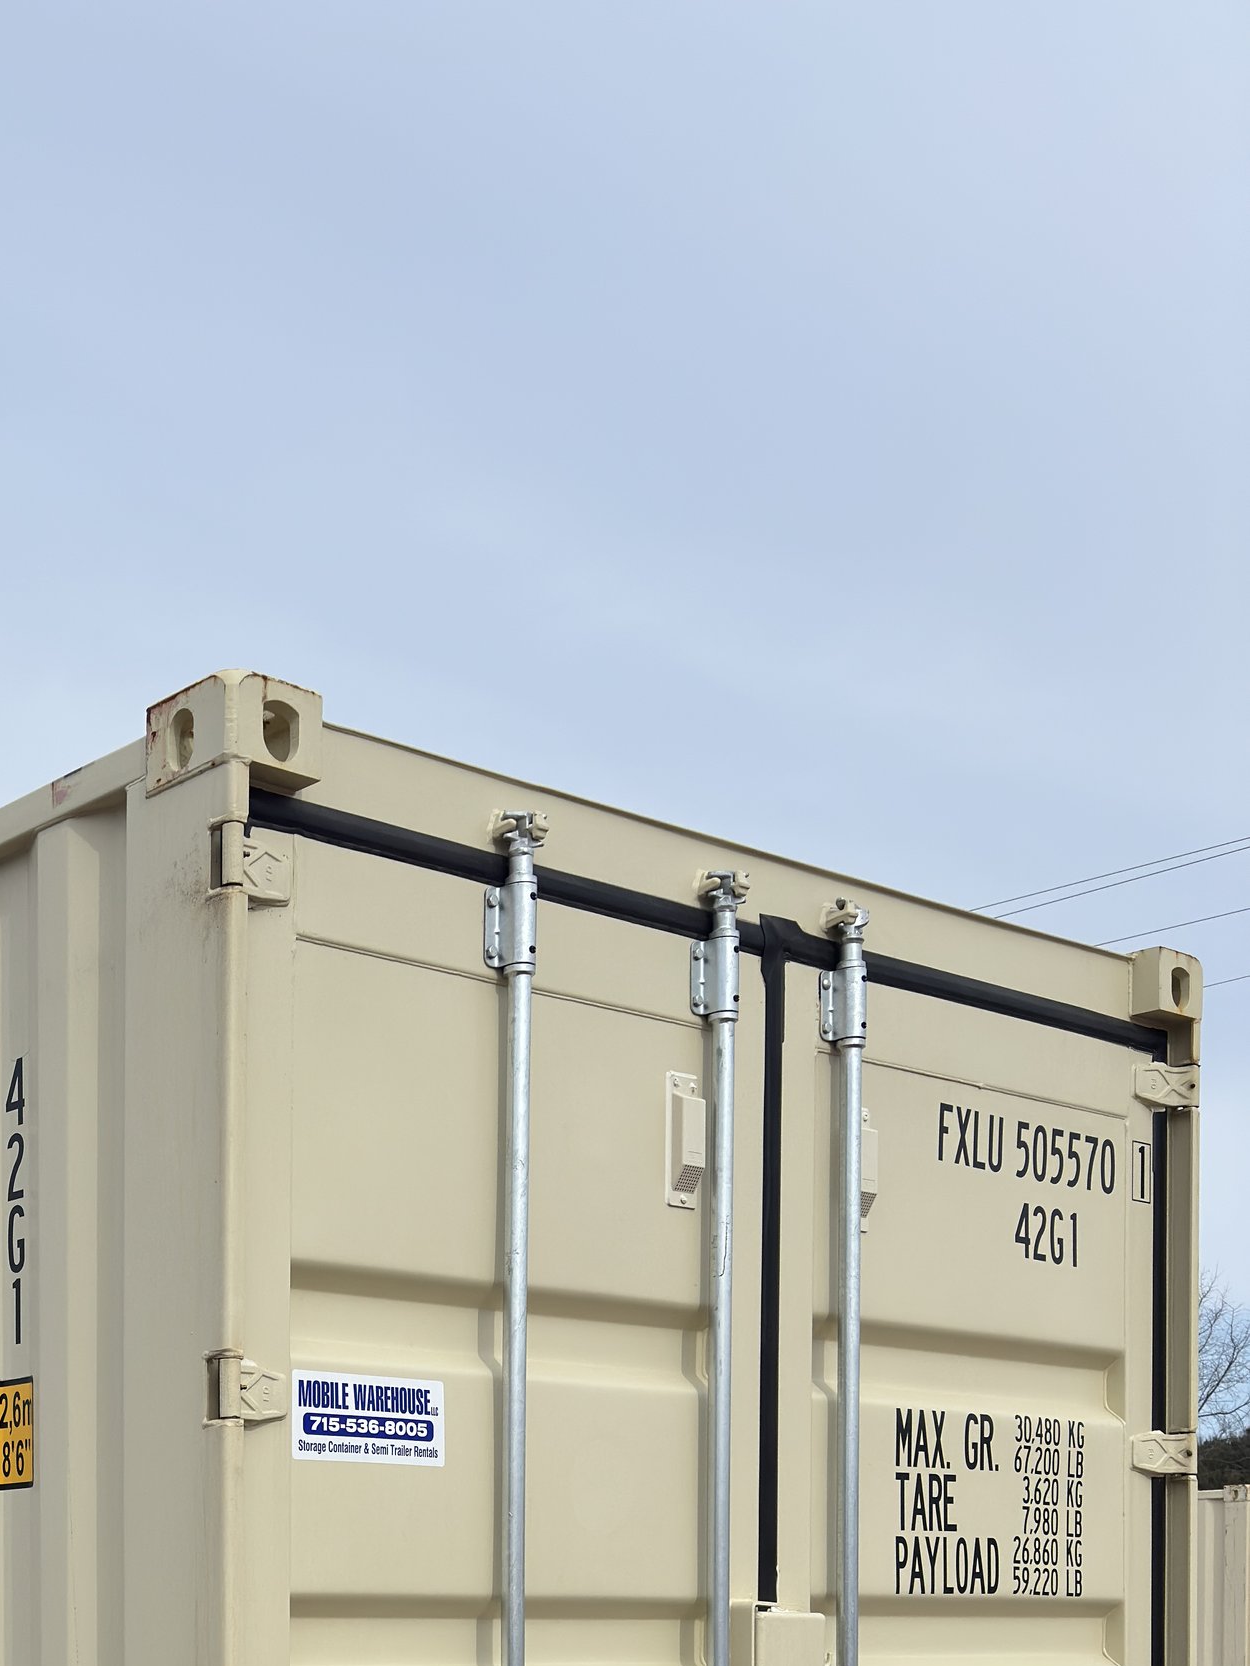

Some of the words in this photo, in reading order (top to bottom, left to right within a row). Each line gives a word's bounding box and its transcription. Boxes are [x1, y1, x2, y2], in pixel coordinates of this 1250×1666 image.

[938, 1103, 1004, 1173] FXLU
[1015, 1120, 1116, 1194] 505570
[5, 1057, 25, 1344] 42G1
[1014, 1202, 1078, 1268] 42G1
[298, 1379, 349, 1410] MOBILE
[353, 1383, 431, 1416] WAREHOUSE
[309, 1415, 428, 1437] 715-536-8005
[895, 1408, 951, 1469] MAX.
[964, 1413, 999, 1472] GR.
[1014, 1414, 1060, 1446] 30,480
[1068, 1420, 1084, 1449] KG
[298, 1439, 326, 1455] Storage
[328, 1441, 362, 1454] Container
[363, 1443, 369, 1454] &
[371, 1444, 389, 1456] Semi
[390, 1445, 412, 1457] Trailer
[413, 1446, 439, 1459] Rentals
[1014, 1445, 1060, 1476] 67,200
[1067, 1450, 1084, 1478] LB
[895, 1472, 958, 1532] TARE
[1022, 1476, 1059, 1506] 3,620
[1066, 1479, 1083, 1508] KG
[1022, 1506, 1059, 1536] 7,980
[1066, 1510, 1082, 1537] LB
[895, 1535, 1000, 1595] PAYLOAD
[1013, 1536, 1059, 1566] 26,860
[1066, 1539, 1083, 1567] KG
[1013, 1566, 1059, 1596] 59,220
[1066, 1569, 1083, 1597] LB
